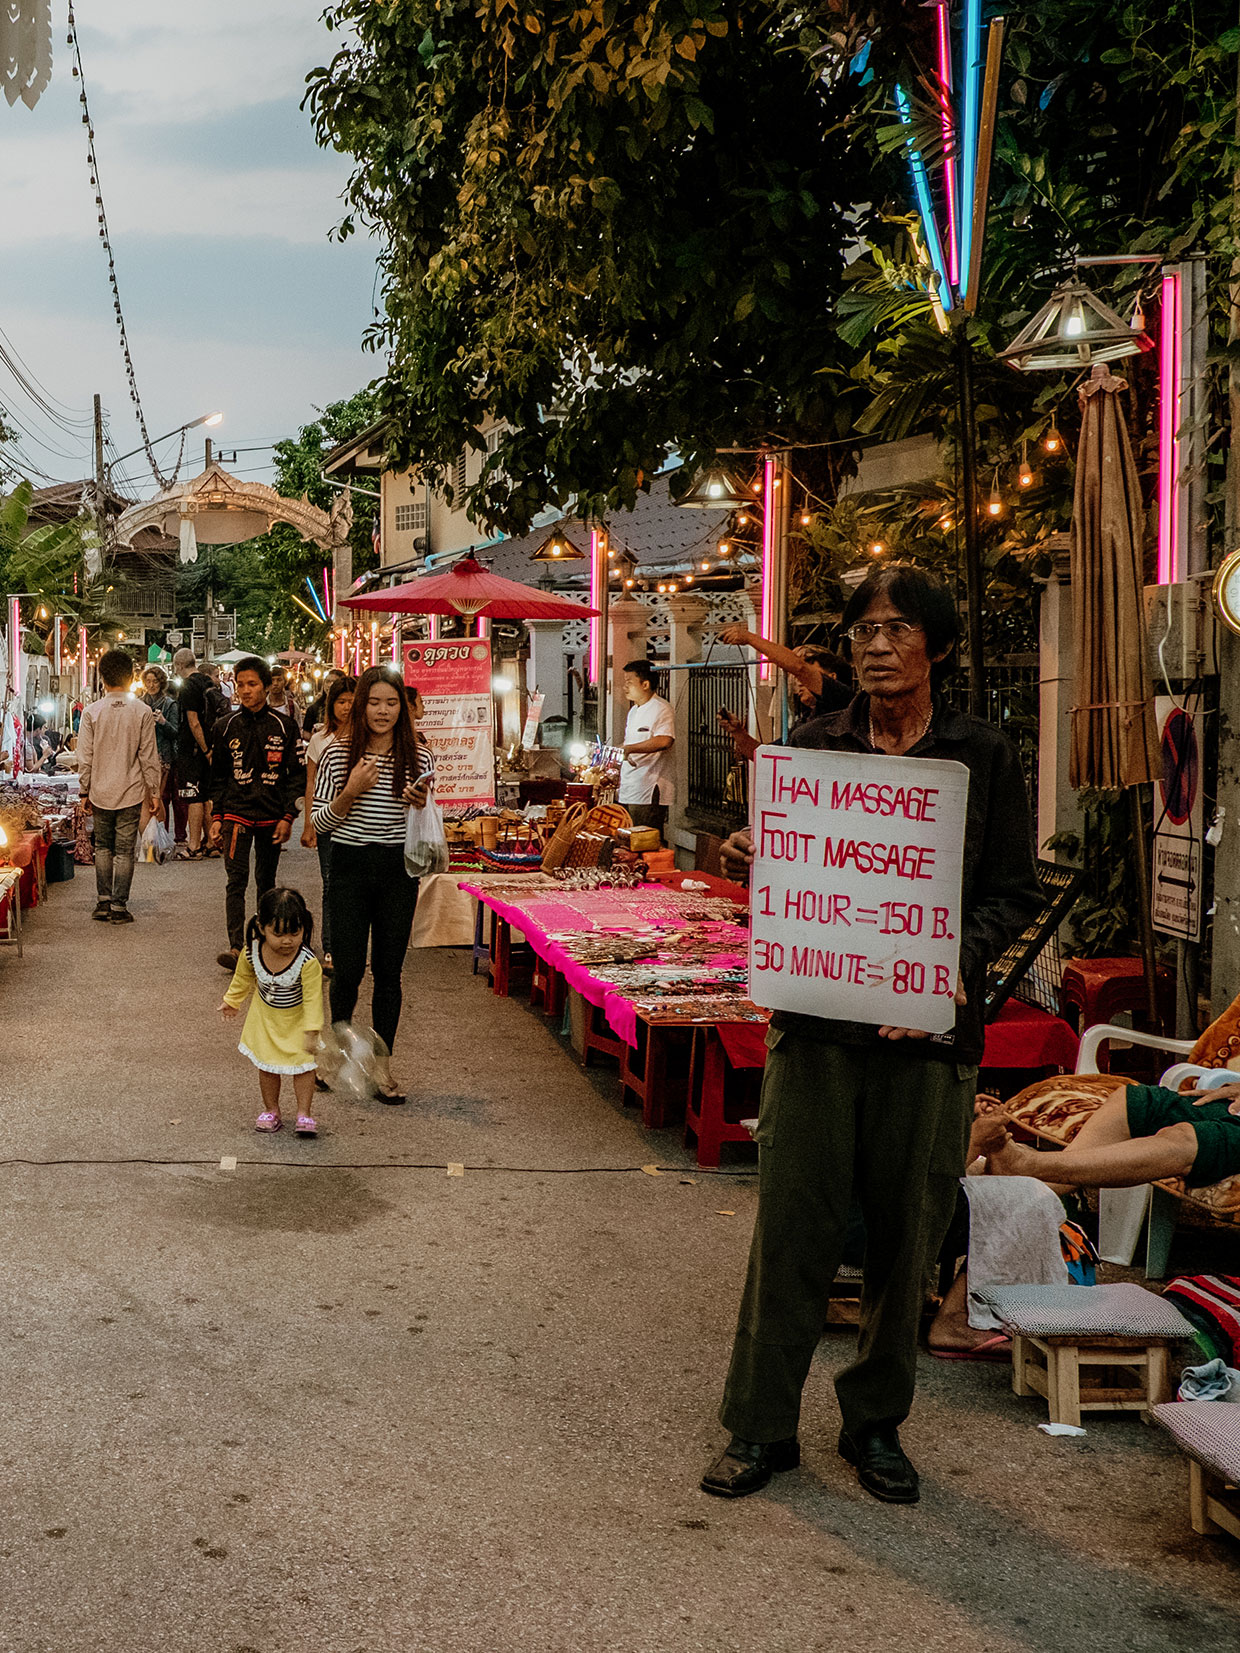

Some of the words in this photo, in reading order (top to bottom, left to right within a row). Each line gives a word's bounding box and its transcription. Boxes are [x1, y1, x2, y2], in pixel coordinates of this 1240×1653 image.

[422, 645, 470, 667] ดูดวง
[761, 754, 820, 807] THAI
[831, 780, 940, 823] MASSAGE
[760, 811, 816, 863] FOOT
[823, 836, 936, 881] MASSAGE
[758, 885, 776, 917] 1
[931, 906, 955, 940] B.
[754, 939, 785, 973] 30
[892, 958, 925, 995] 80
[931, 964, 954, 999] B.
